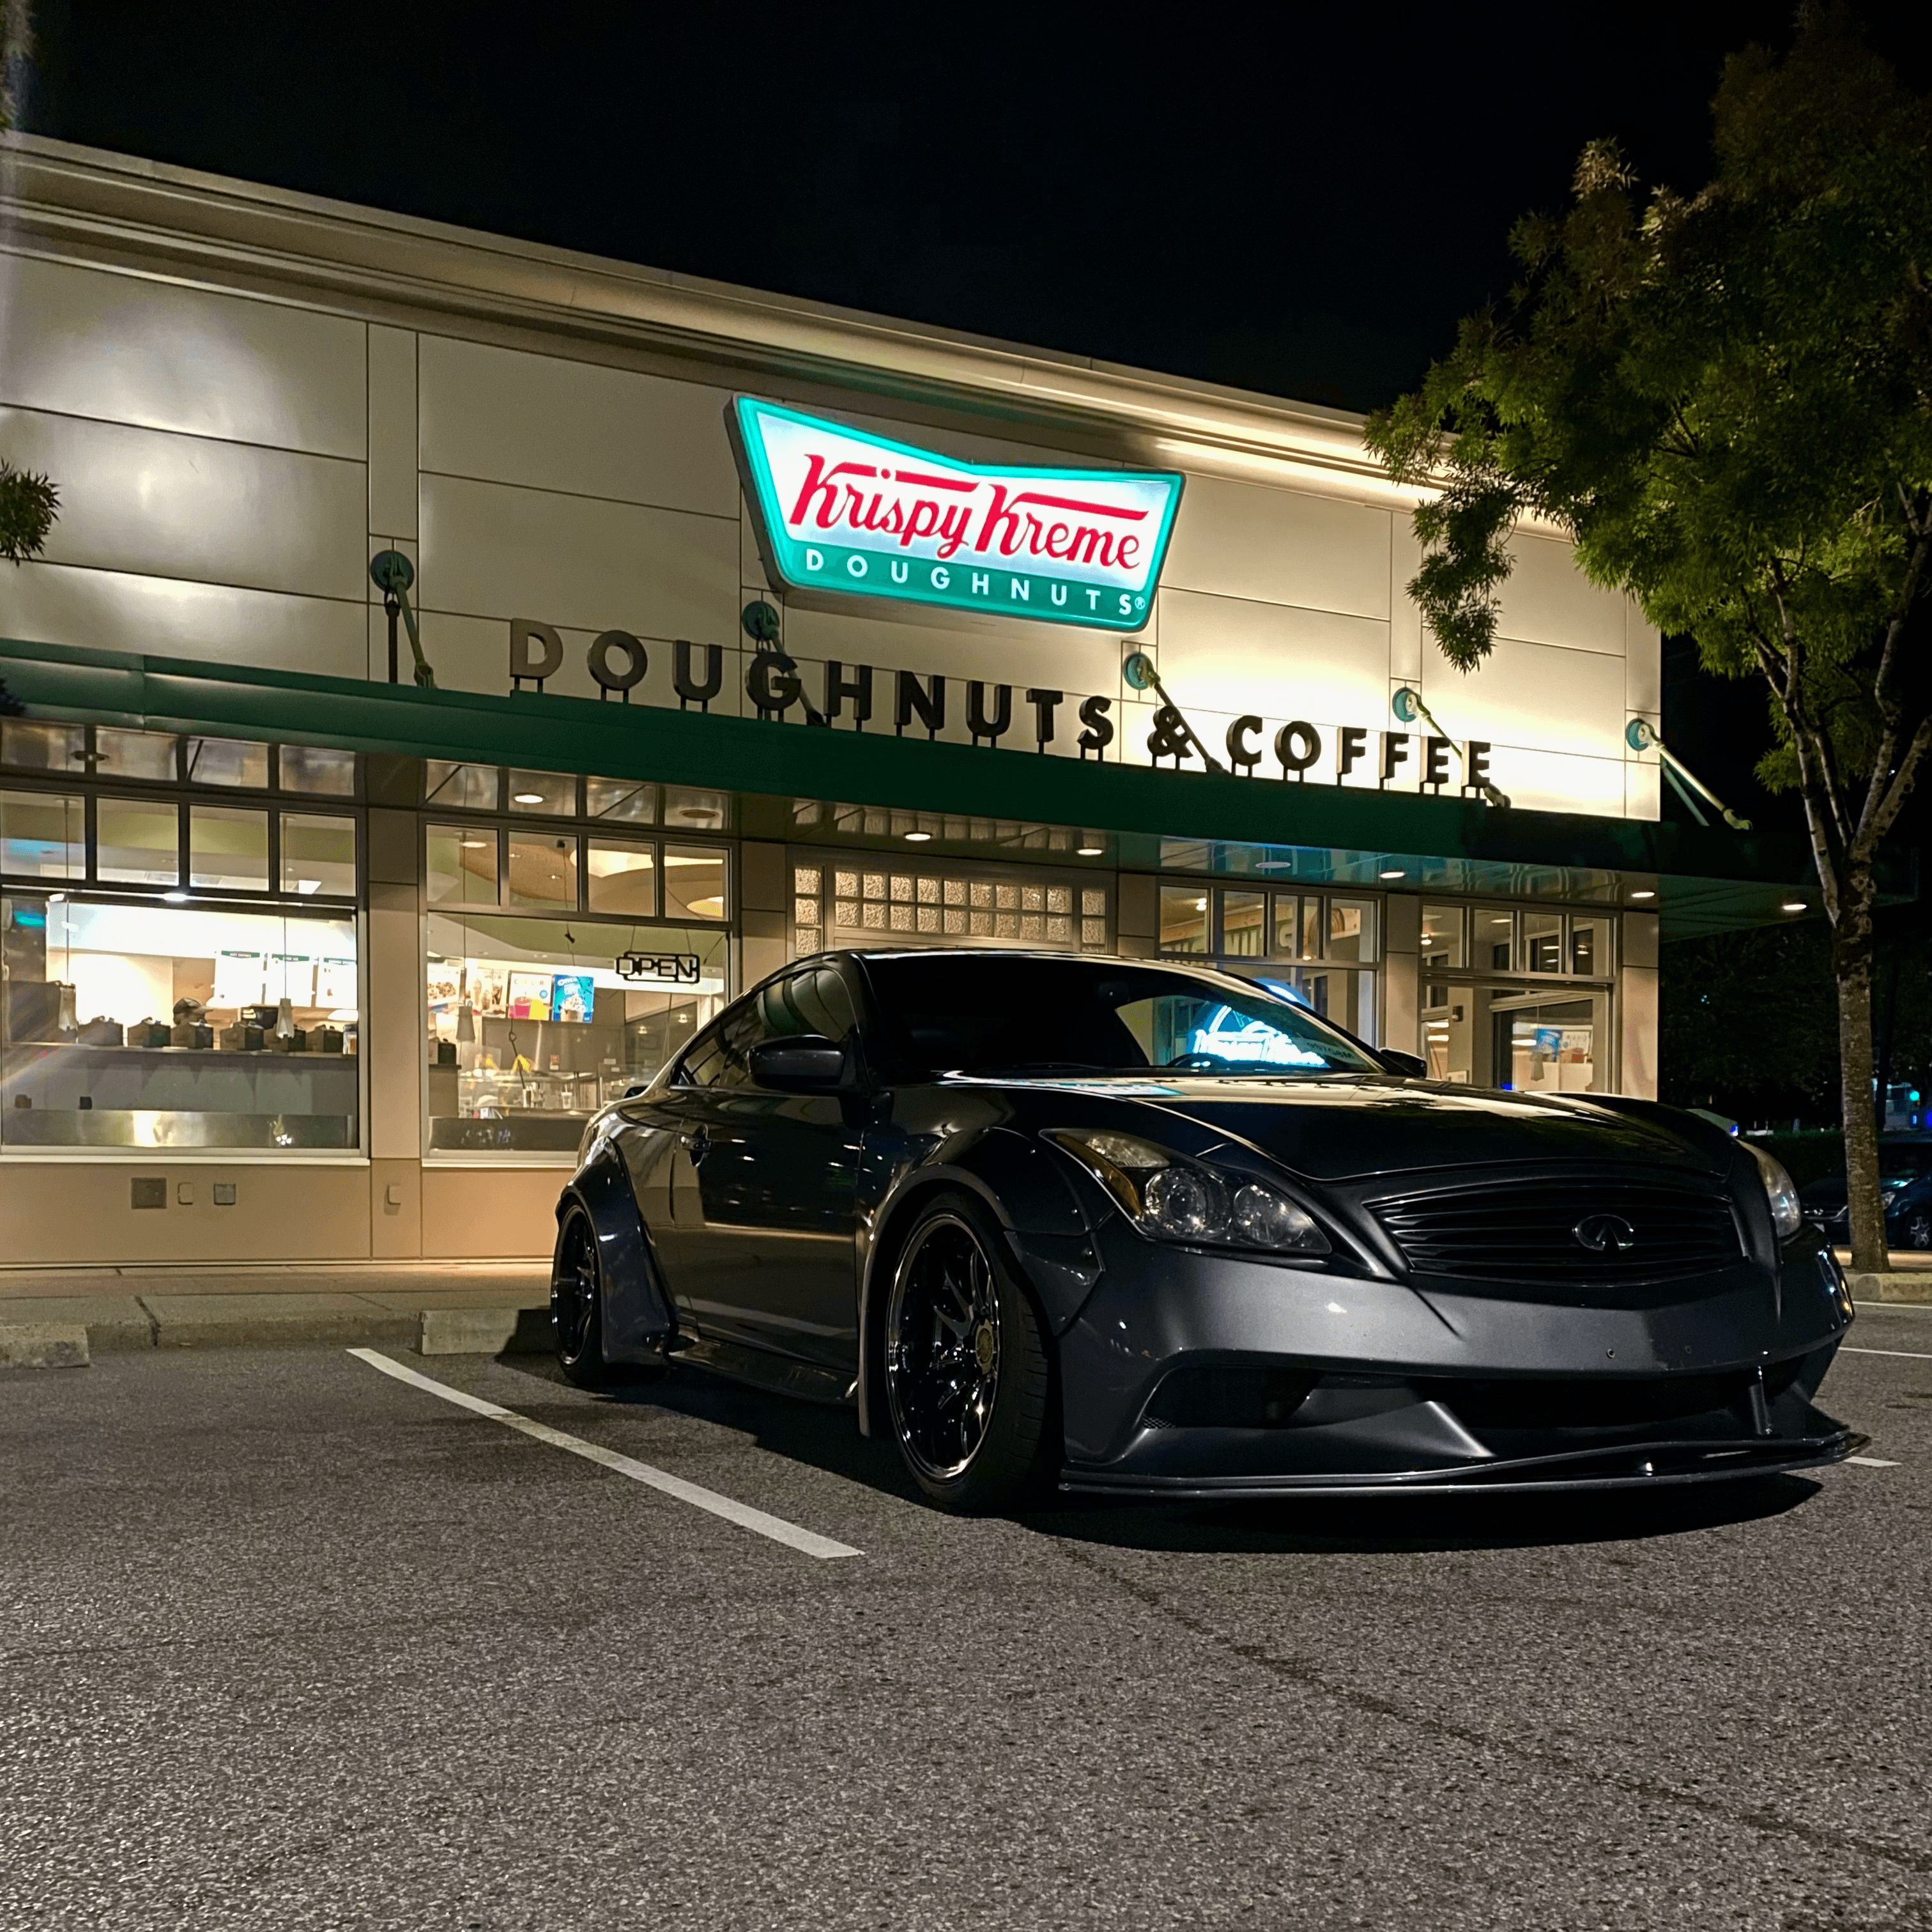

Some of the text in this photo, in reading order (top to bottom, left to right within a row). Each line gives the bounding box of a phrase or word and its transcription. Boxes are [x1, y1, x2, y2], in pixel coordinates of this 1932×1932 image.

[789, 454, 1149, 569] Krispy Kreme
[510, 617, 1491, 788] DOUGHNUTS & COFFEE
[615, 956, 694, 979] OPEN
